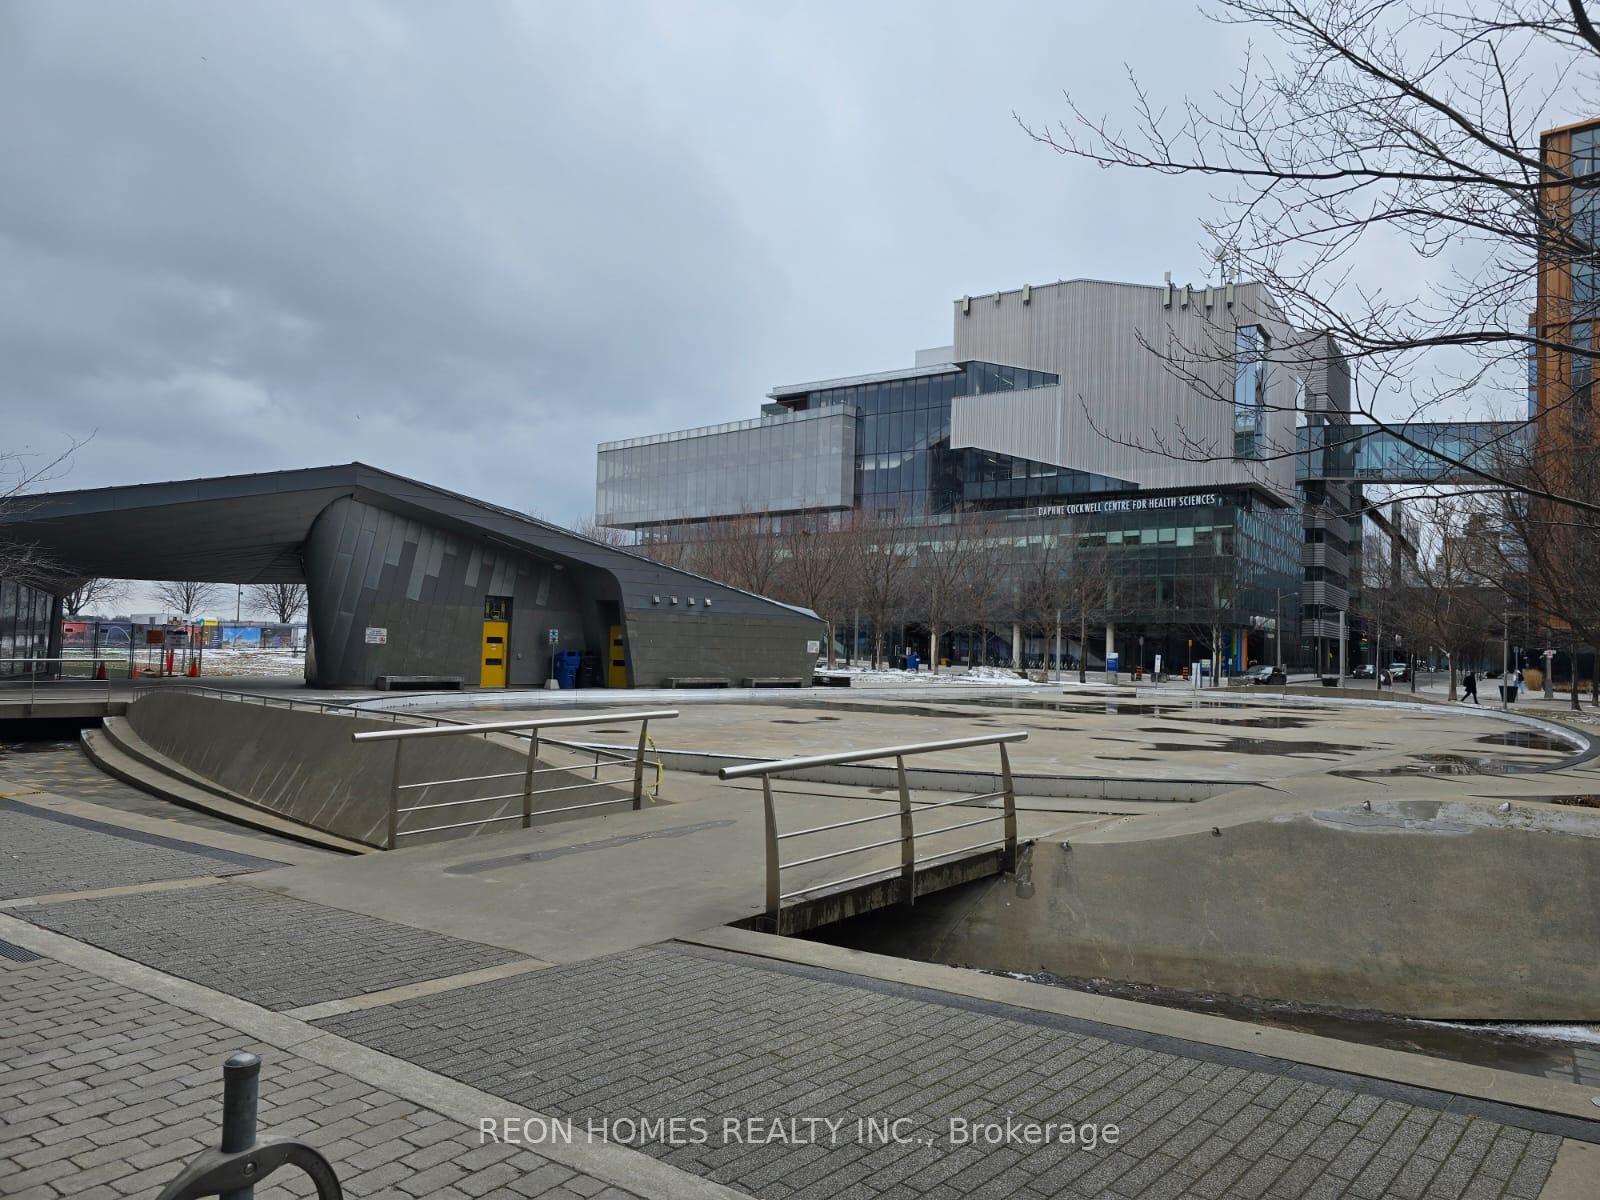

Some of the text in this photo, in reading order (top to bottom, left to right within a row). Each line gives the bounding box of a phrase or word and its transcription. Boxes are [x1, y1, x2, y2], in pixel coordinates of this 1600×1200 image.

[1038, 494, 1215, 516] DAPHNE COCKWELL CENTRE FOR HEALTH SCIENCES
